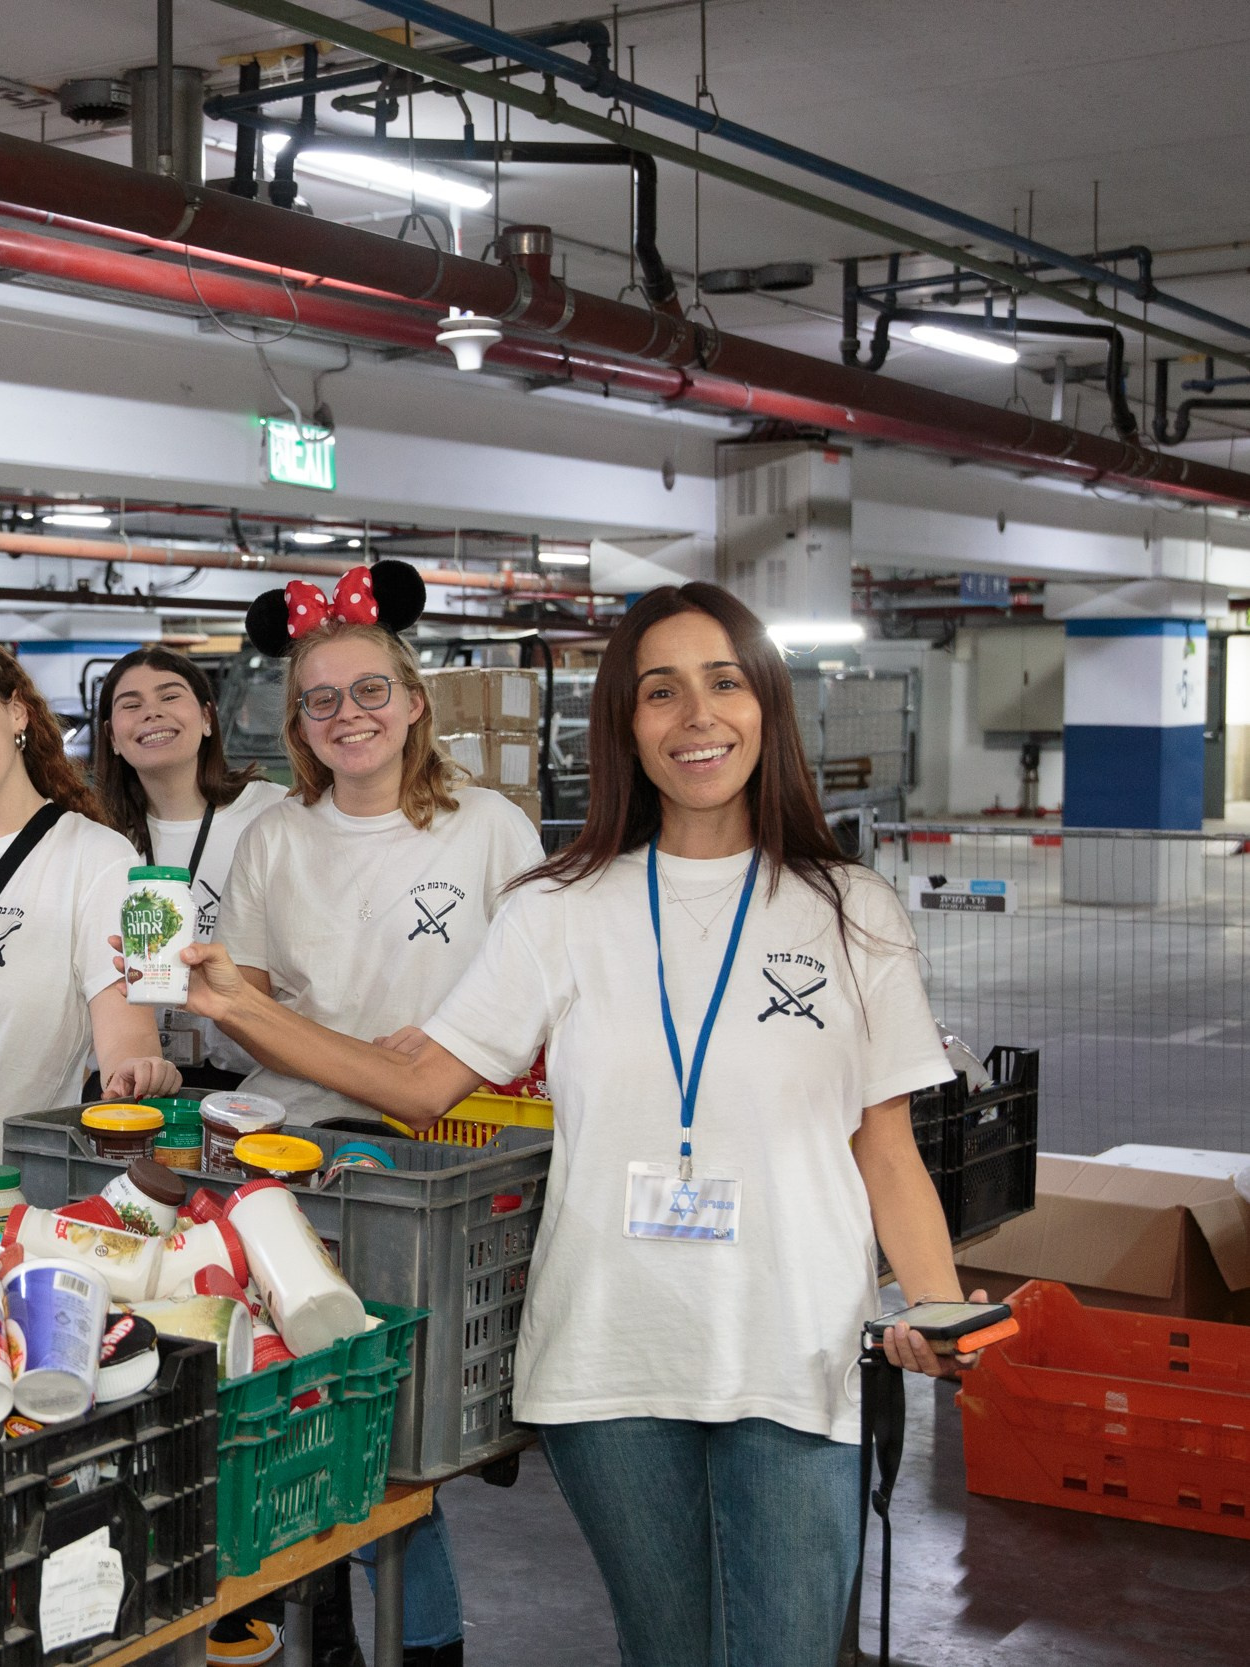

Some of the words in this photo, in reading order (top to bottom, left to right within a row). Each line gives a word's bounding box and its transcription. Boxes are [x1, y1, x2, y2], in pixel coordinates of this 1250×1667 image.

[427, 881, 448, 890] חרבות
[448, 884, 466, 900] מבצע
[126, 909, 164, 923] טחינה
[198, 914, 217, 925] בות
[127, 922, 164, 936] אחוה
[766, 952, 792, 964] ברזל
[794, 953, 826, 974] חרבות
